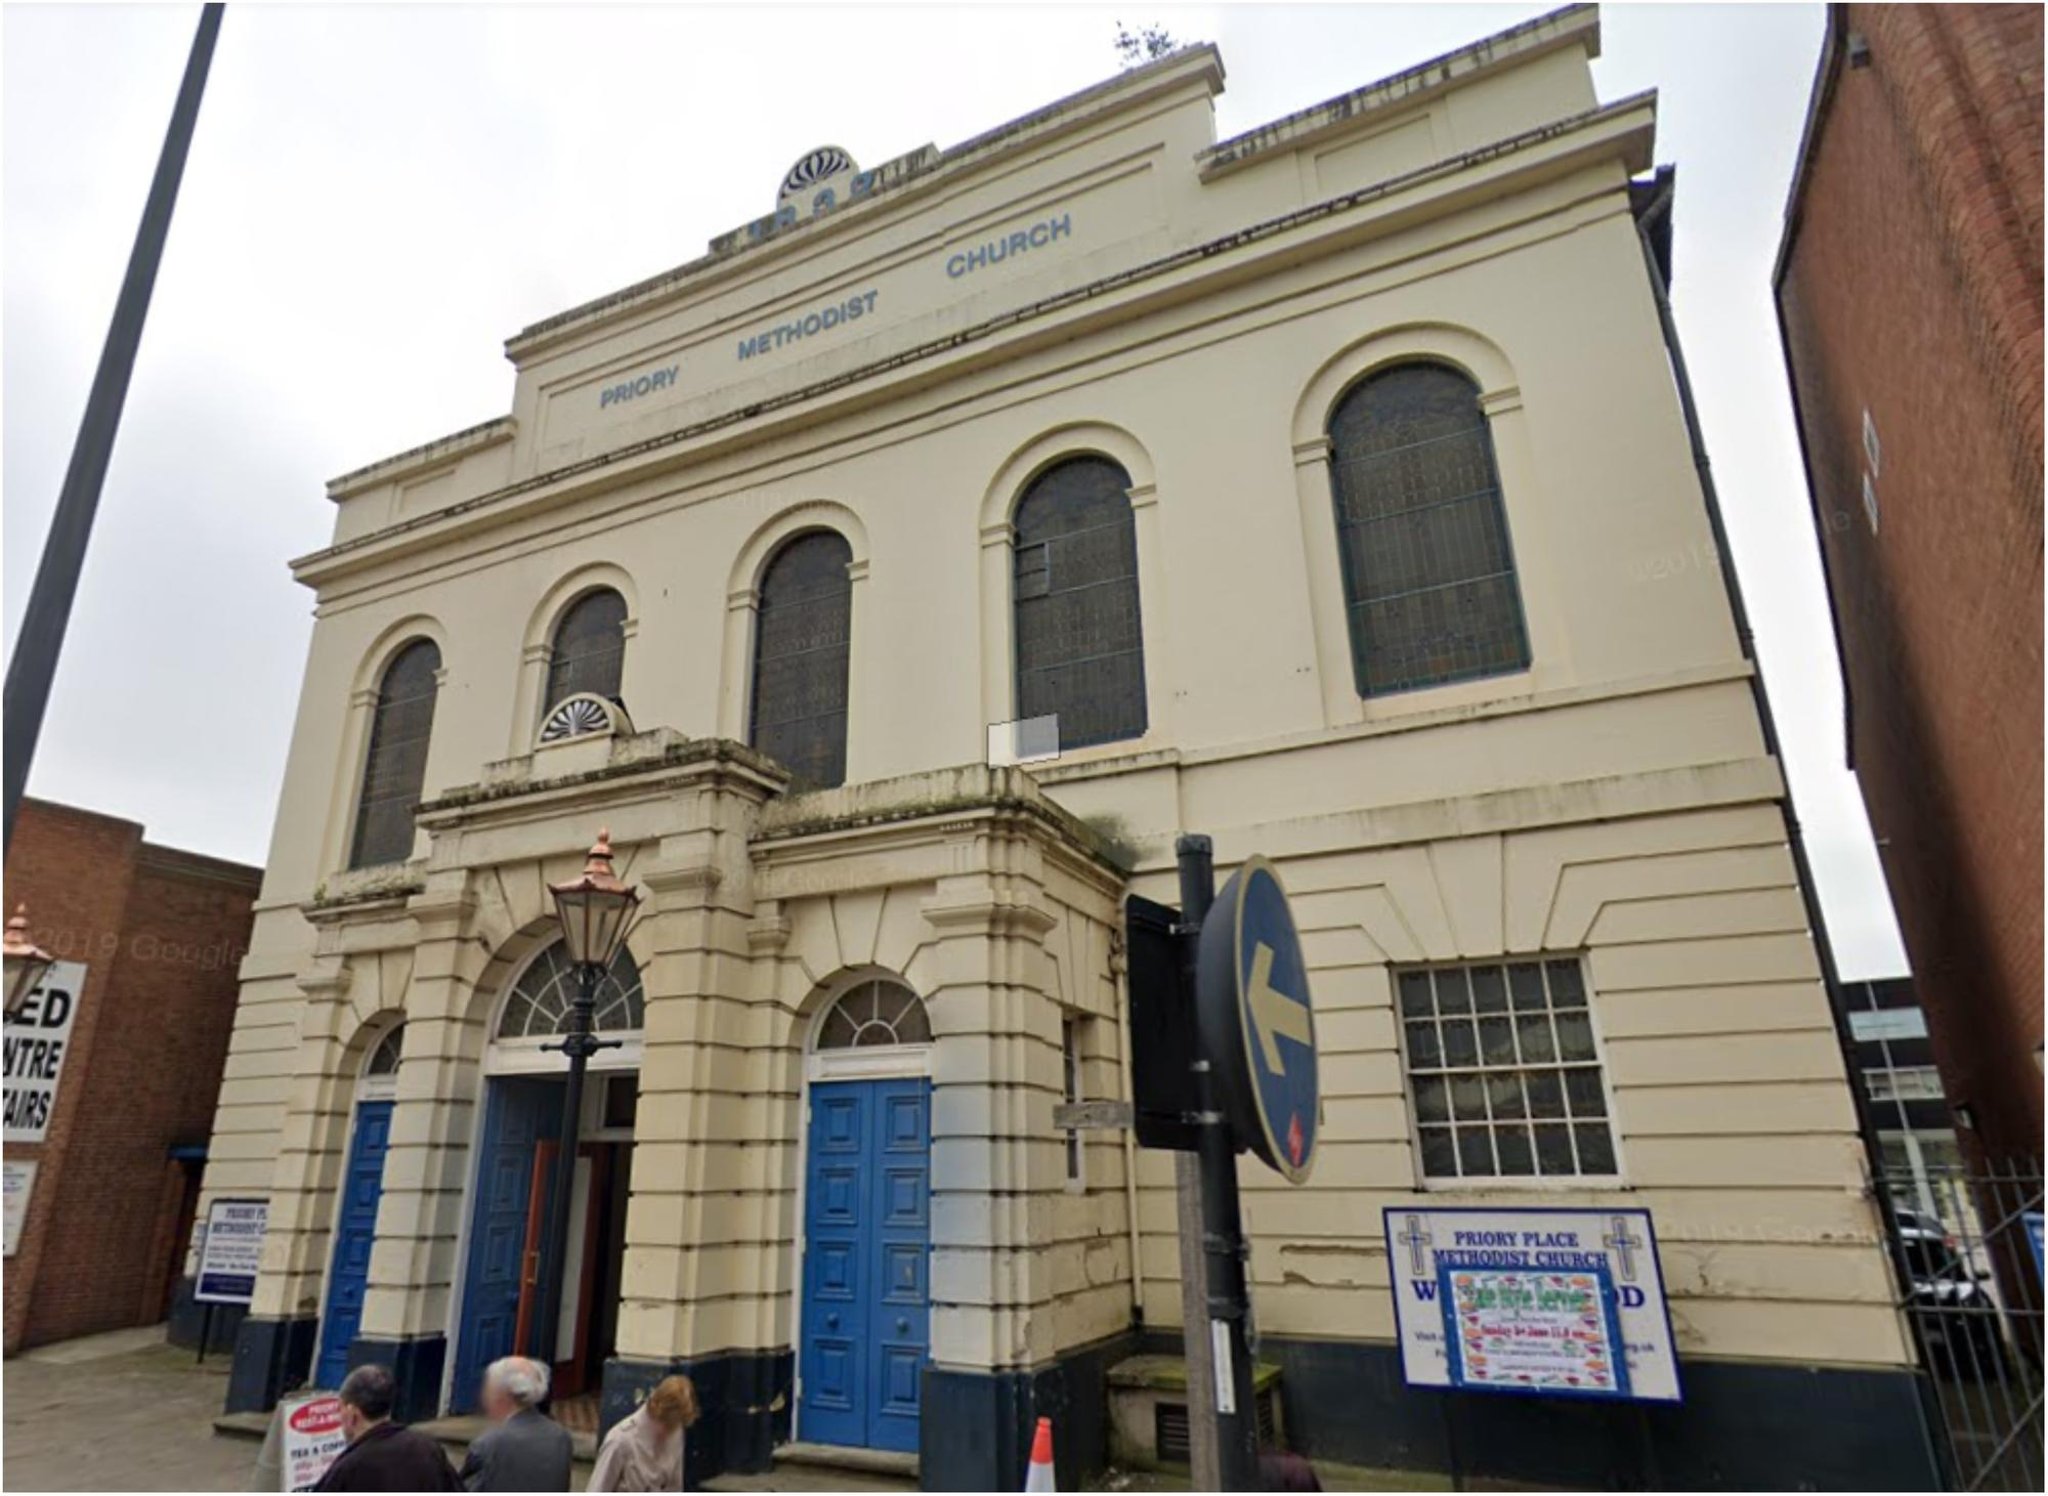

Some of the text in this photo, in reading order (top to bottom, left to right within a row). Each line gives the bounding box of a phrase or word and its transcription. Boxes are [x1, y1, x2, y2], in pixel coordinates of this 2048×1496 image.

[600, 212, 1072, 409] PRIORY METHODIST CHURCH
[1454, 1231, 1579, 1248] PRIORY PLACE
[1432, 1249, 1608, 1268] METHODIST CHURCH
